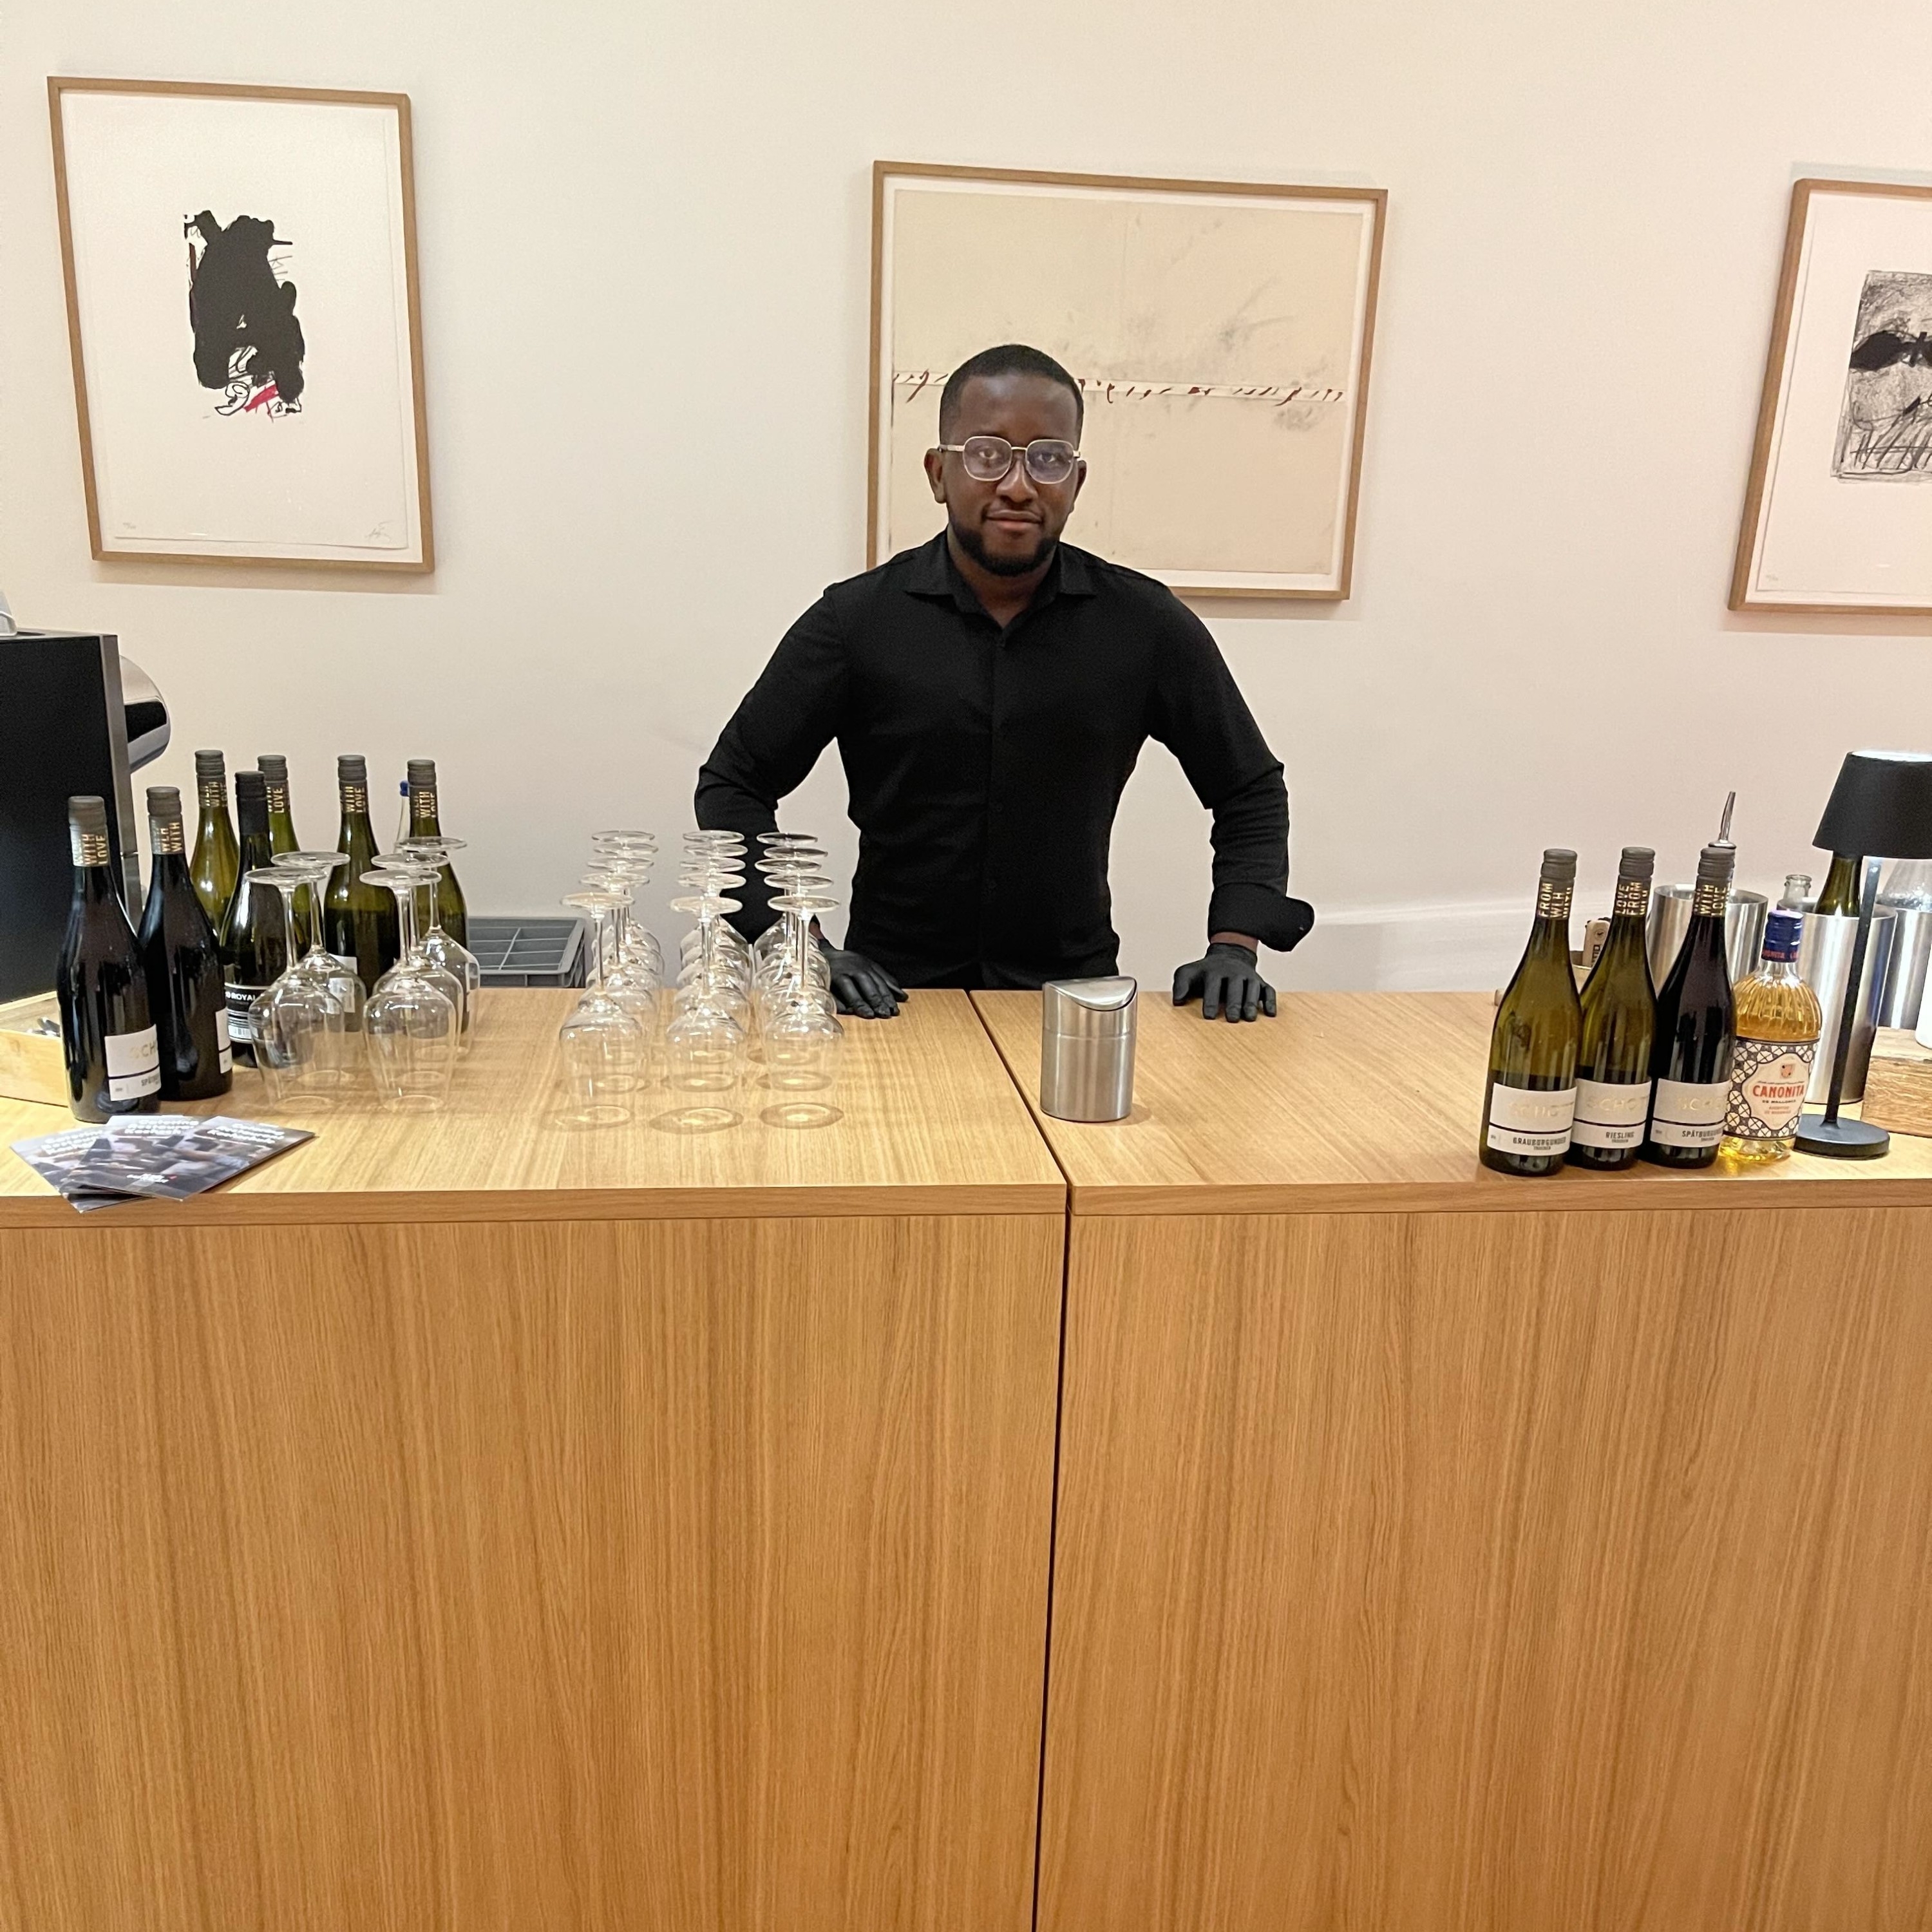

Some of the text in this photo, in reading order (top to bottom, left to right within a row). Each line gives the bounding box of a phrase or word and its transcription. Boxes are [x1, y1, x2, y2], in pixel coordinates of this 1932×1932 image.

[272, 787, 285, 813] LOVE
[419, 791, 431, 818] WITH
[82, 833, 97, 864] WITH
[95, 835, 108, 864] LOVE
[169, 822, 183, 852] WITH
[1537, 882, 1553, 918] FROM
[1615, 884, 1629, 914] LOVE
[1626, 882, 1642, 915] FROM
[1700, 884, 1714, 914] WITH
[1711, 887, 1726, 916] LOVE
[1752, 1084, 1805, 1099] CANONITA
[1605, 1131, 1634, 1140] RIESLING
